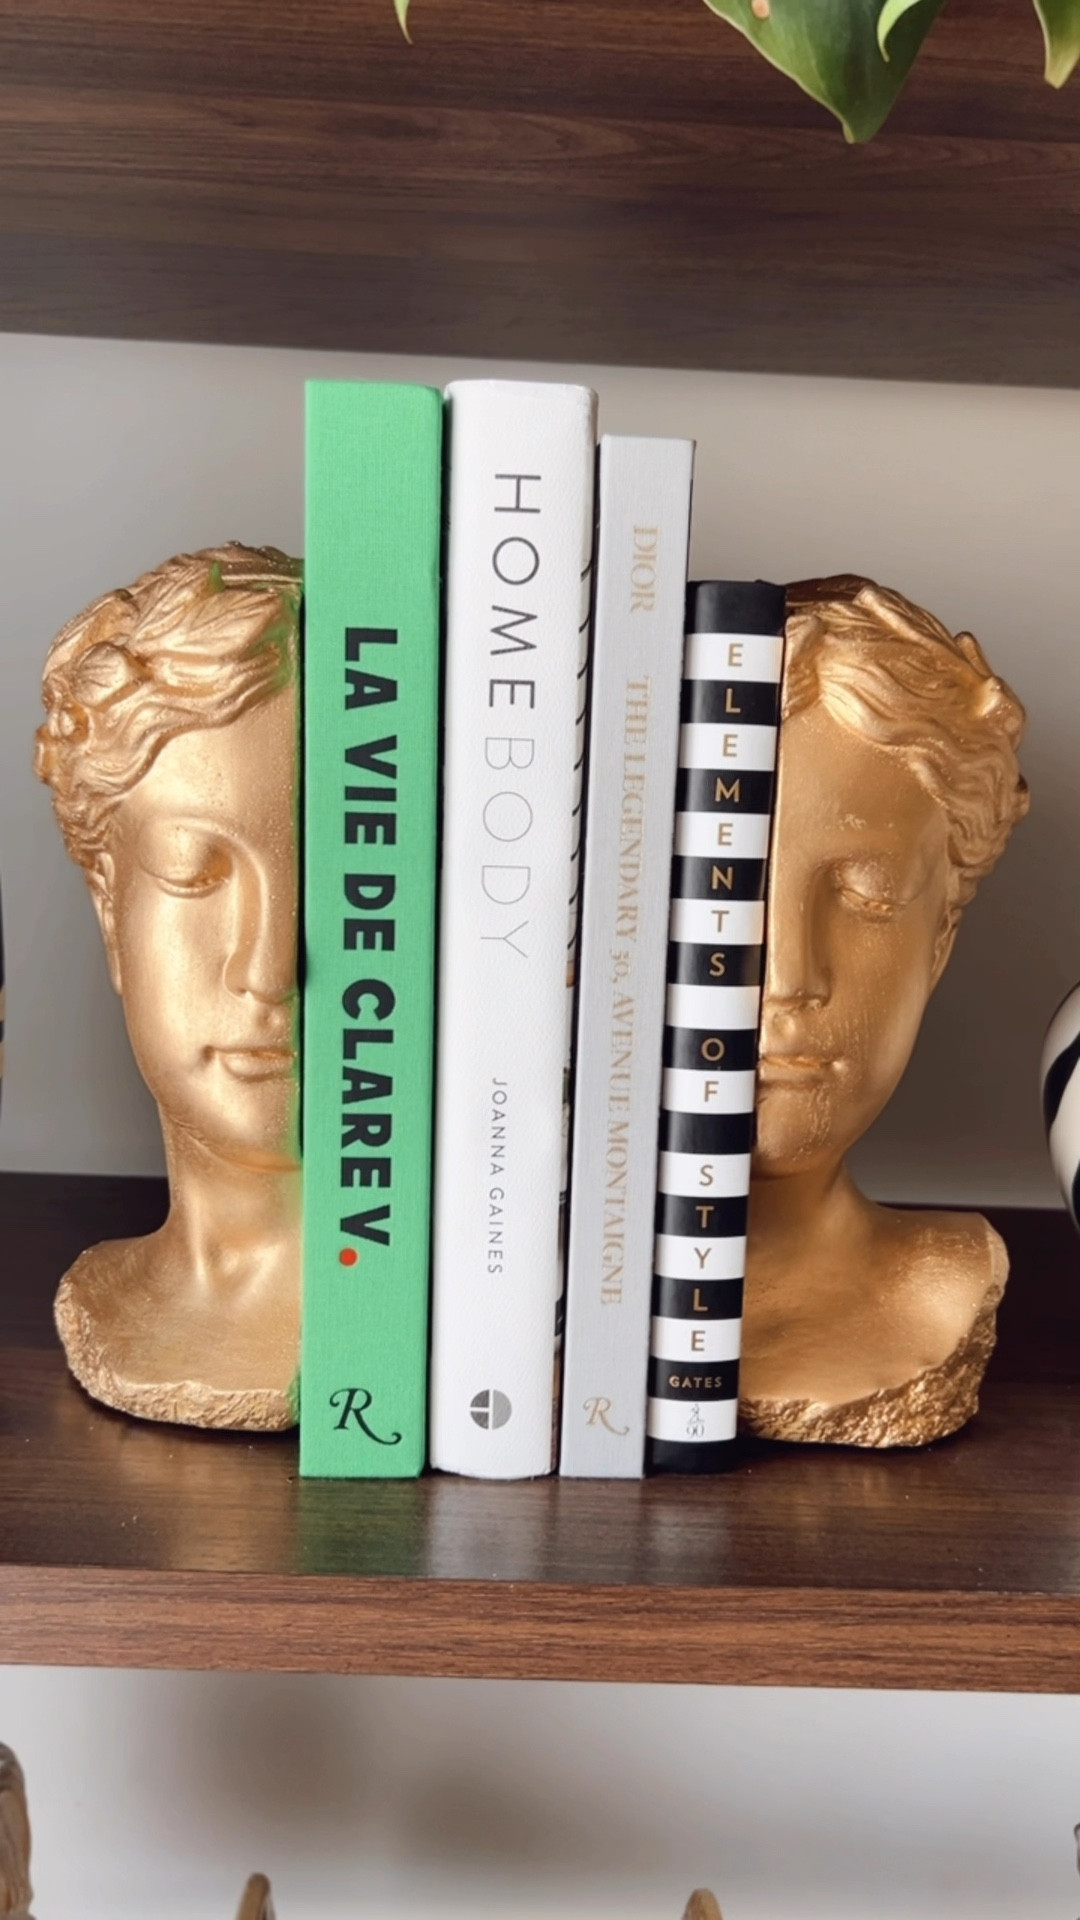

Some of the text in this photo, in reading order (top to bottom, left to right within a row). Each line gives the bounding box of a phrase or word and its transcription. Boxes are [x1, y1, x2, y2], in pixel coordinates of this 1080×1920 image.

[630, 524, 658, 613] DIOR
[345, 627, 397, 710] LA
[480, 473, 541, 959] HOMEBODY
[344, 734, 397, 845] VIE
[344, 873, 396, 951] DE
[601, 675, 651, 1306] THE LEGENDARY 30, AVENUE MONTAIGNE
[691, 643, 744, 1352] ELEMENTS OF STYLE
[487, 1077, 508, 1274] JOANNA GAINES
[329, 1388, 402, 1445] R
[582, 1397, 629, 1436] R
[668, 1375, 723, 1388] GATES
